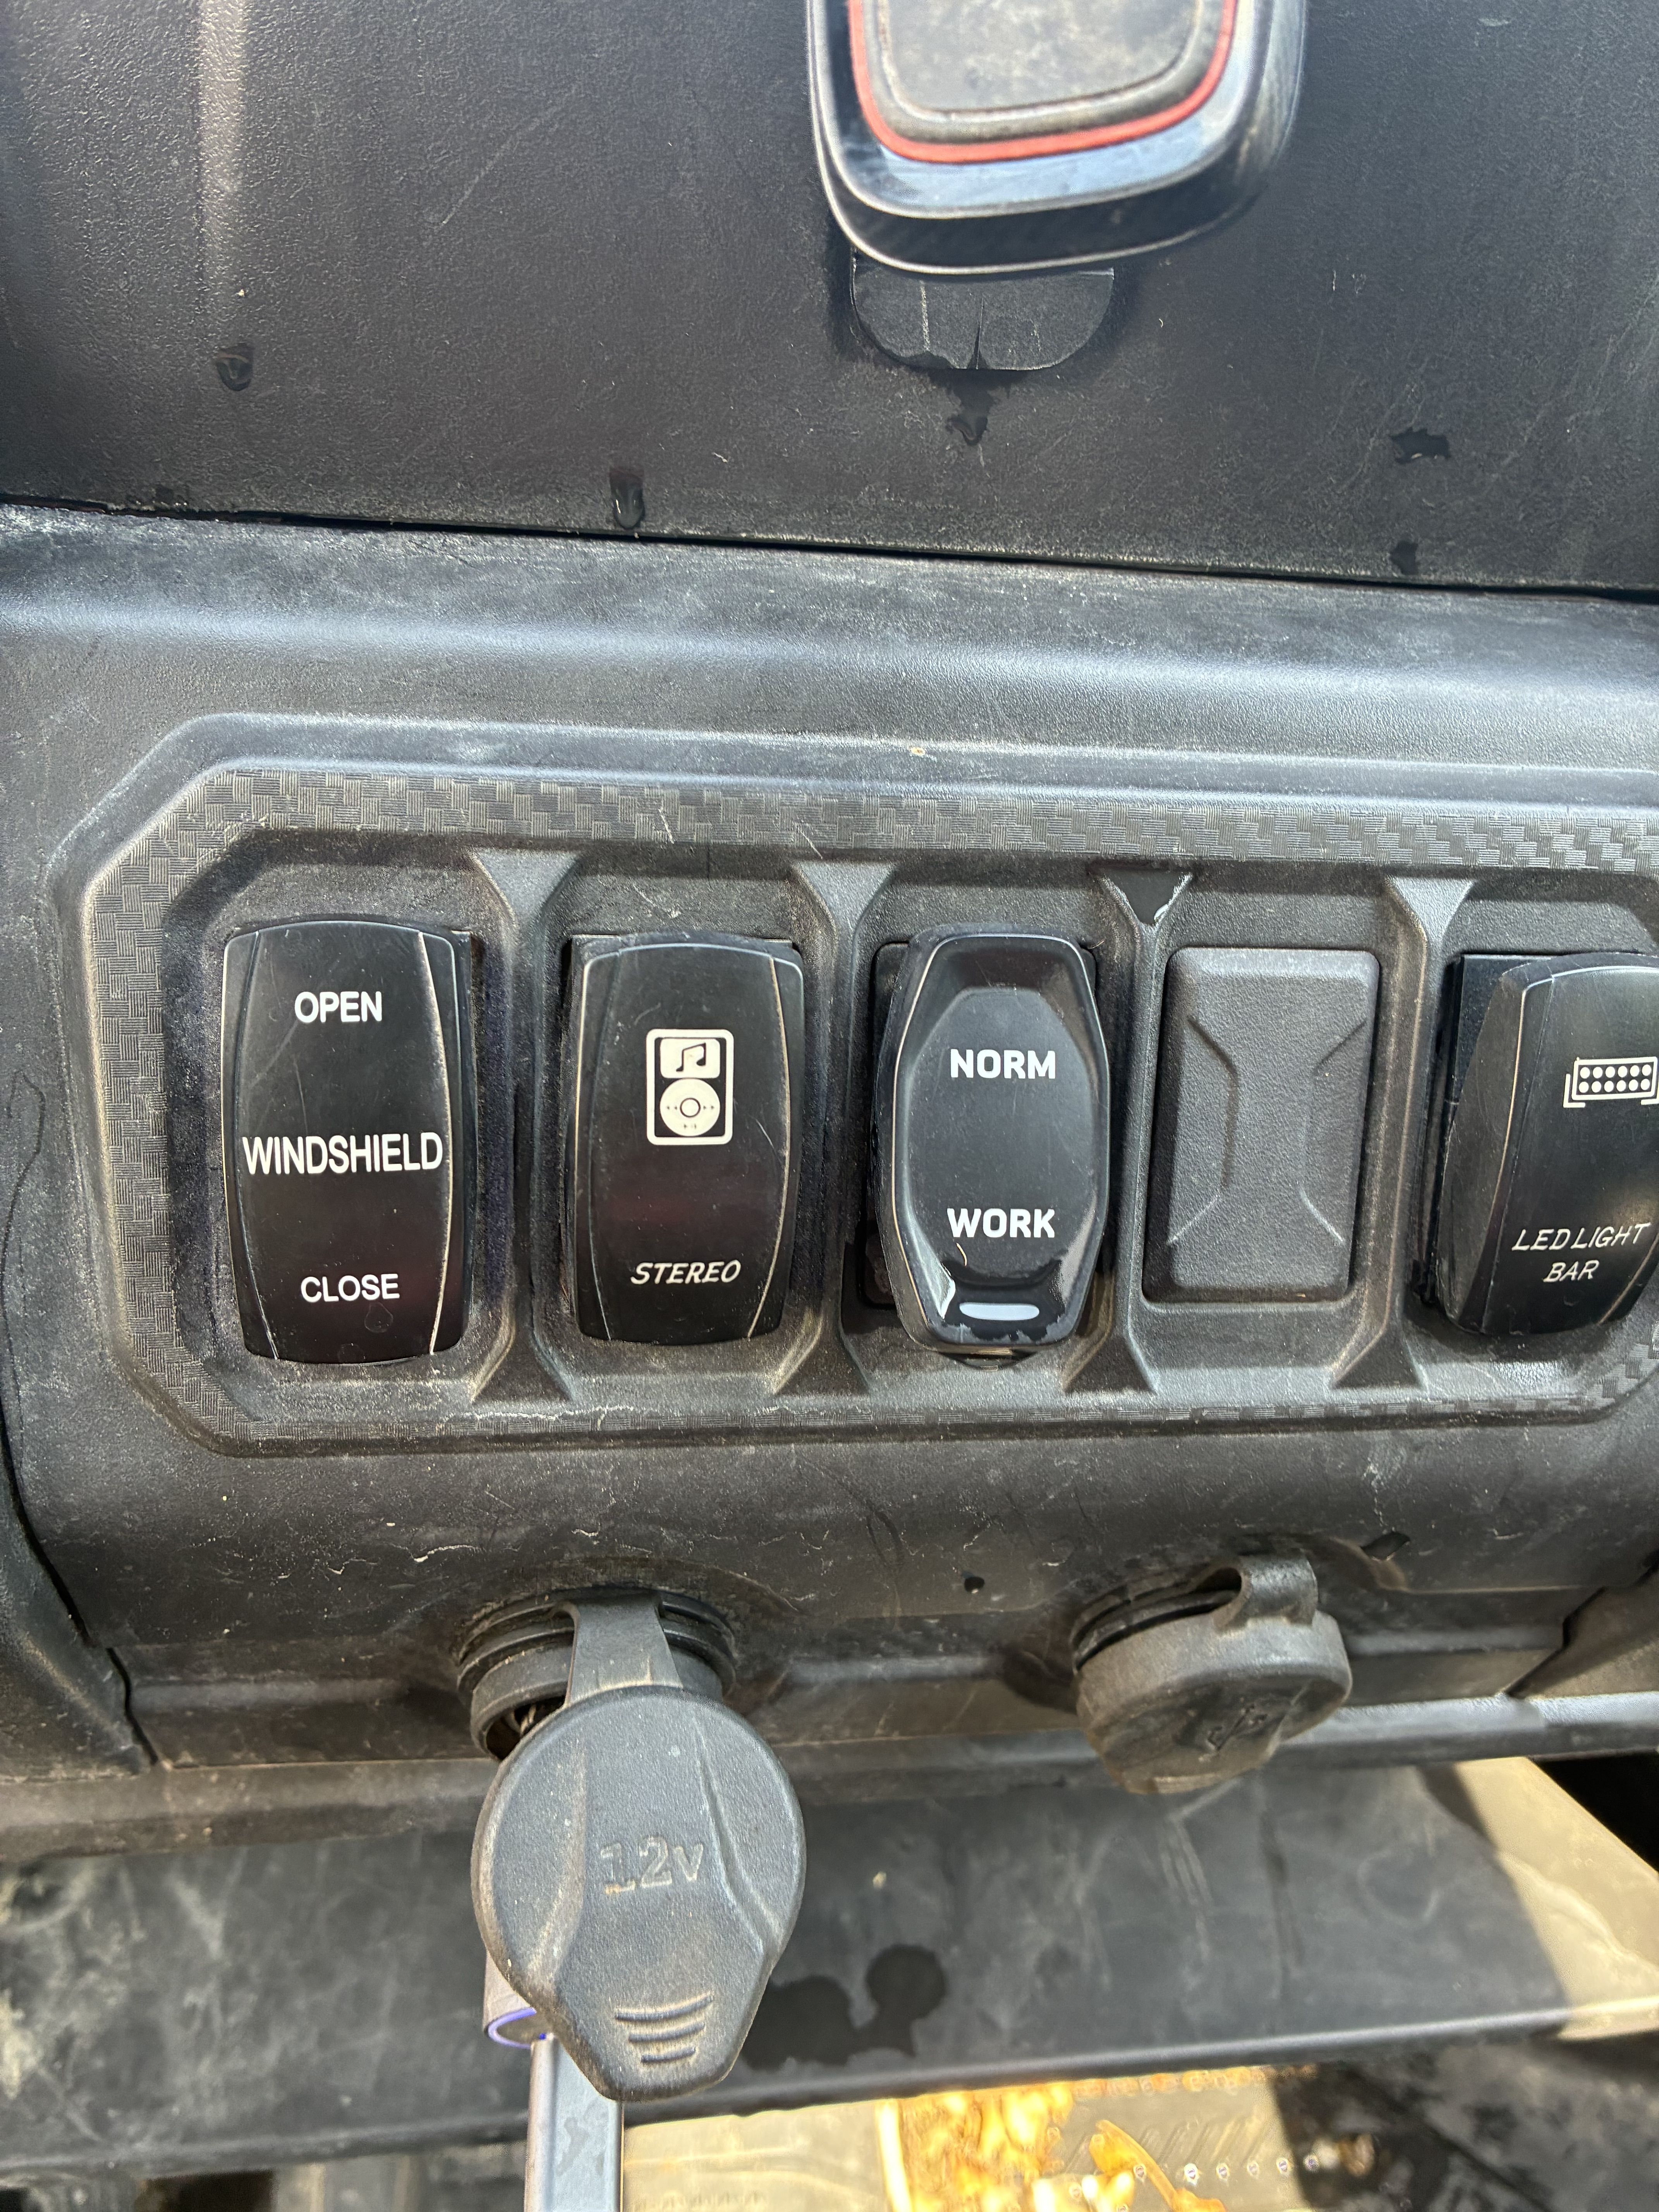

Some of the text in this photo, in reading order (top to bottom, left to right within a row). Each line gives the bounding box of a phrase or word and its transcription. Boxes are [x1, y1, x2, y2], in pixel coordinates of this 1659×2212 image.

[294, 991, 383, 1024] OPEN
[950, 1048, 1056, 1080] NORM
[241, 1132, 443, 1175] WINDSHIELD
[946, 1207, 1055, 1238] WORK
[1511, 1221, 1652, 1251] LED LIGHT
[630, 1259, 741, 1285] STEREO
[1542, 1259, 1600, 1283] BAR
[300, 1273, 400, 1303] CLOSE
